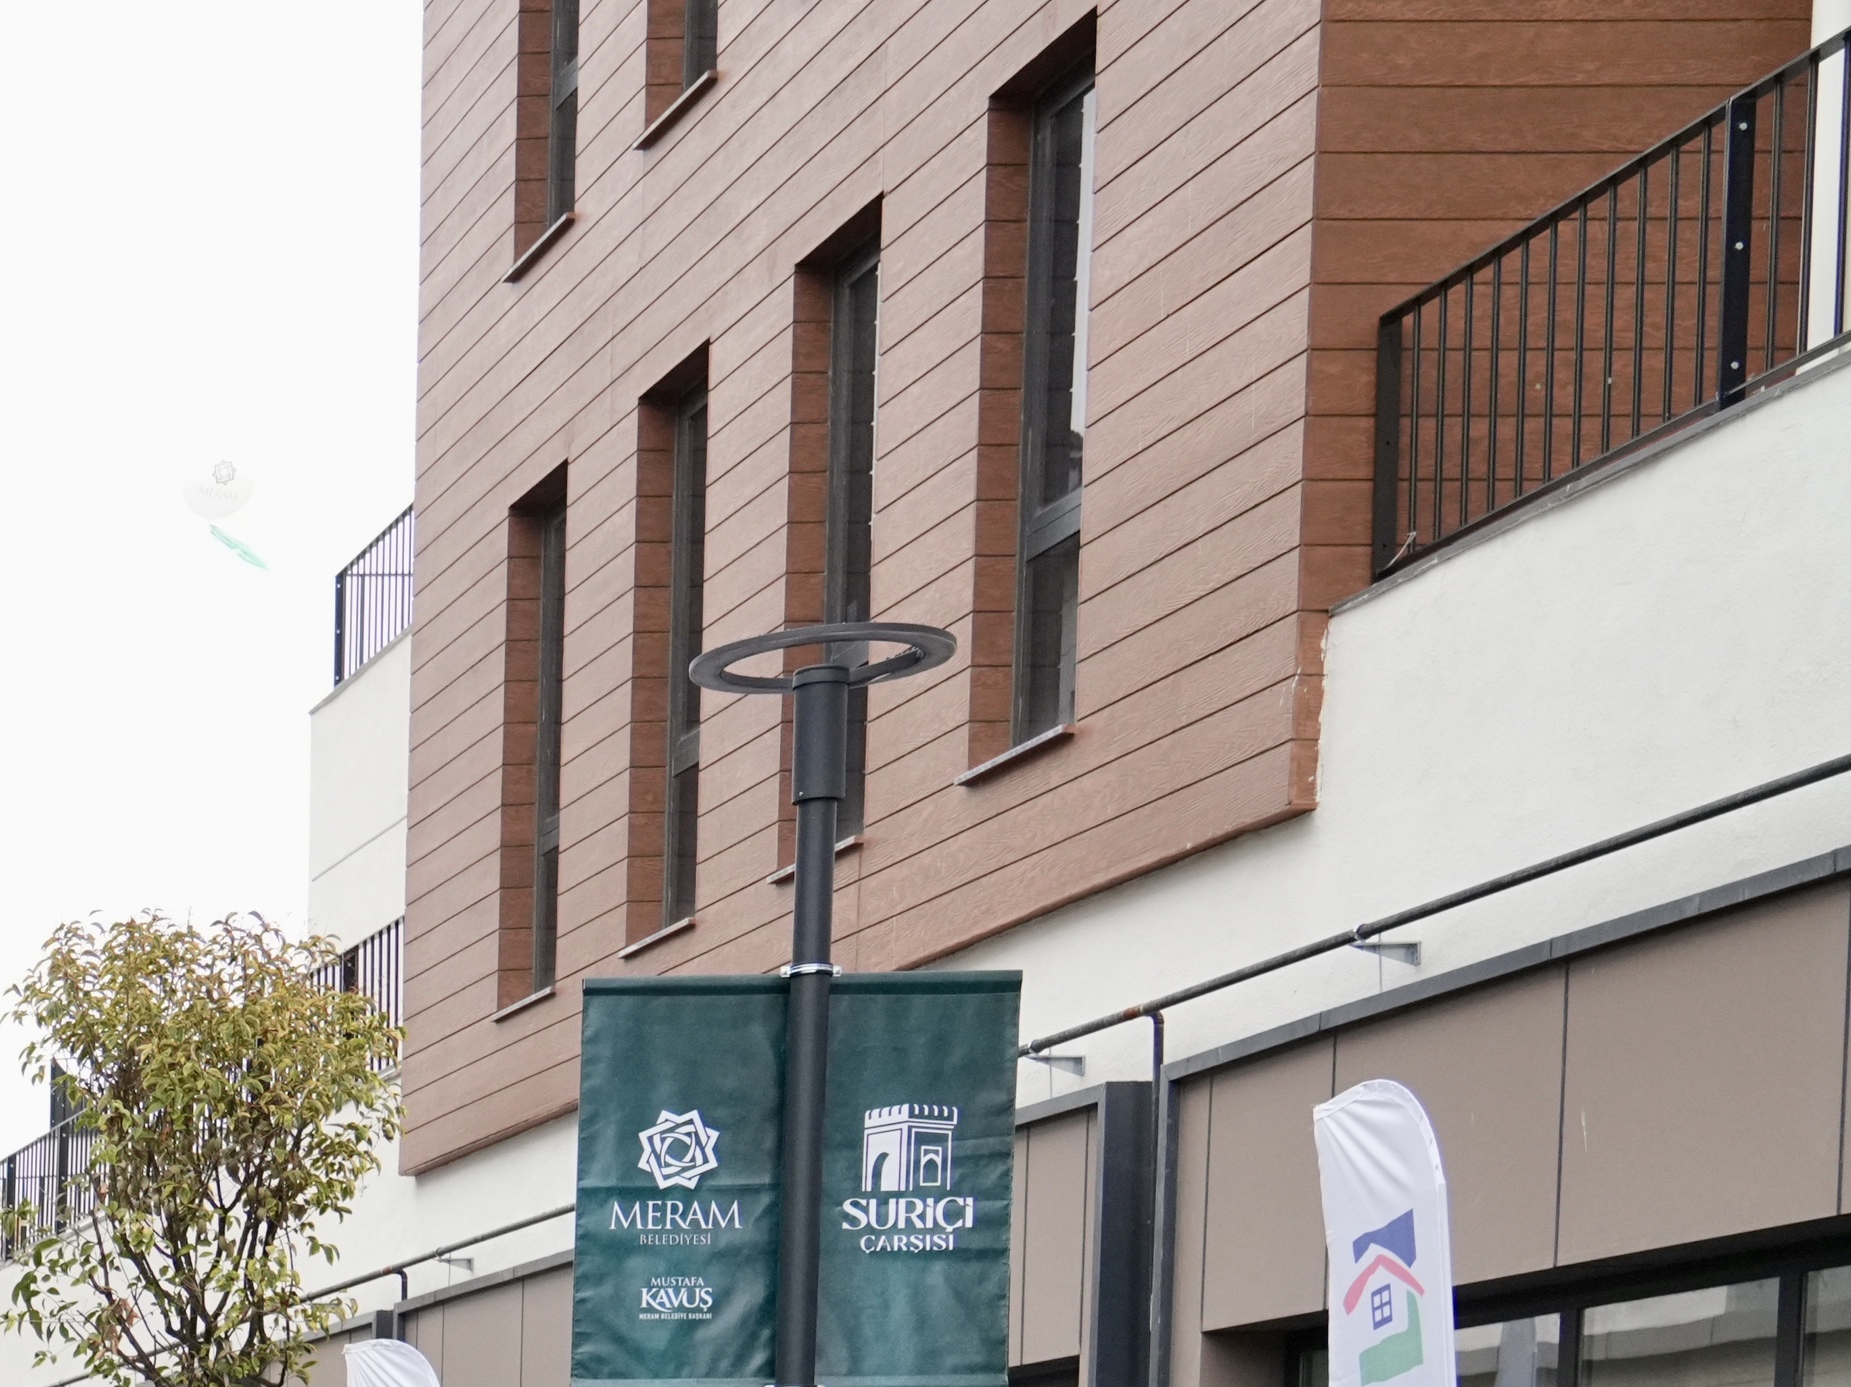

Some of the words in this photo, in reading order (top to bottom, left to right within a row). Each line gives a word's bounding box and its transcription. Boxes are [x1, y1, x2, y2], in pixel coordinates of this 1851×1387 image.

[609, 1200, 743, 1231] MERAM
[842, 1197, 974, 1232] SURİÇİ
[639, 1232, 712, 1246] BELEDİYESİ
[650, 1276, 705, 1287] MUSTAFA
[640, 1287, 713, 1313] KAVUŞ
